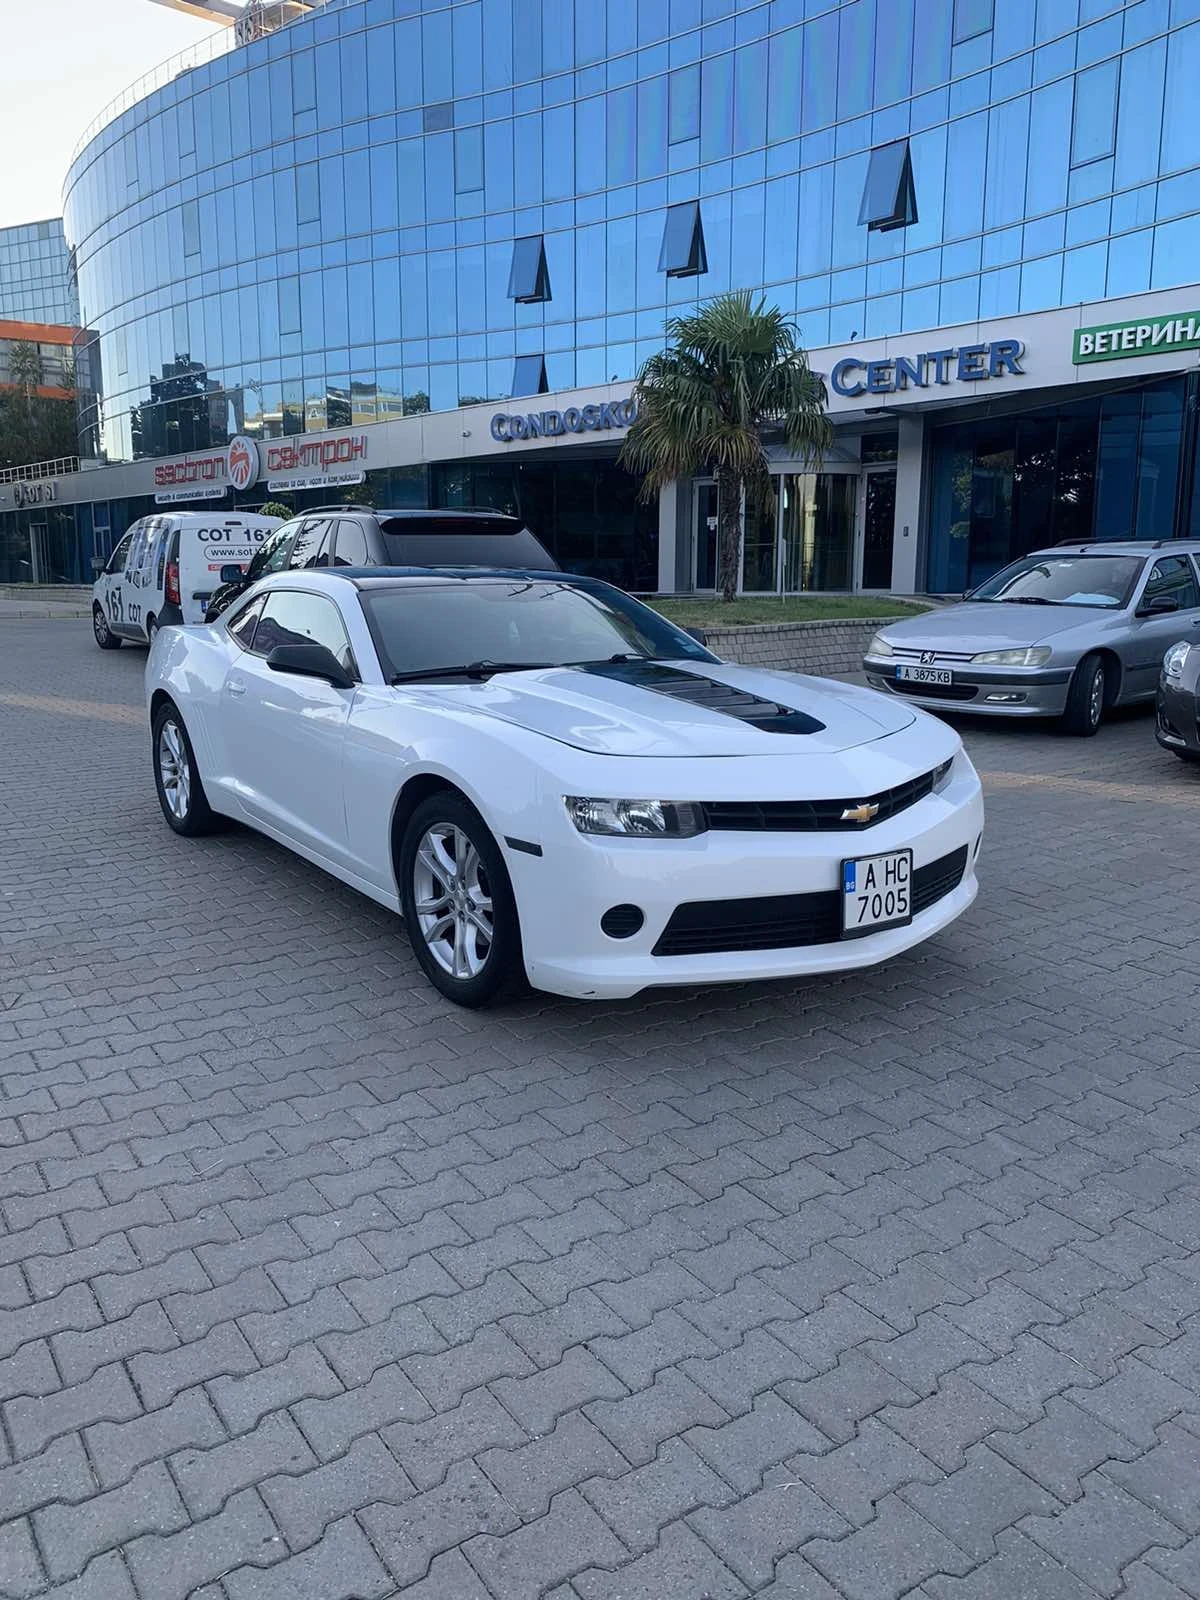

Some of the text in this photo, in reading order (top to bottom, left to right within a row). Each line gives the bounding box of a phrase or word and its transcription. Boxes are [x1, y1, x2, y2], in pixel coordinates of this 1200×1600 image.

[1079, 318, 1200, 355] ВЕТЕРИН
[831, 339, 1025, 397] CENTER
[904, 668, 910, 679] A
[845, 881, 855, 891] BG
[865, 857, 908, 890] A HC
[858, 887, 908, 923] 7005
